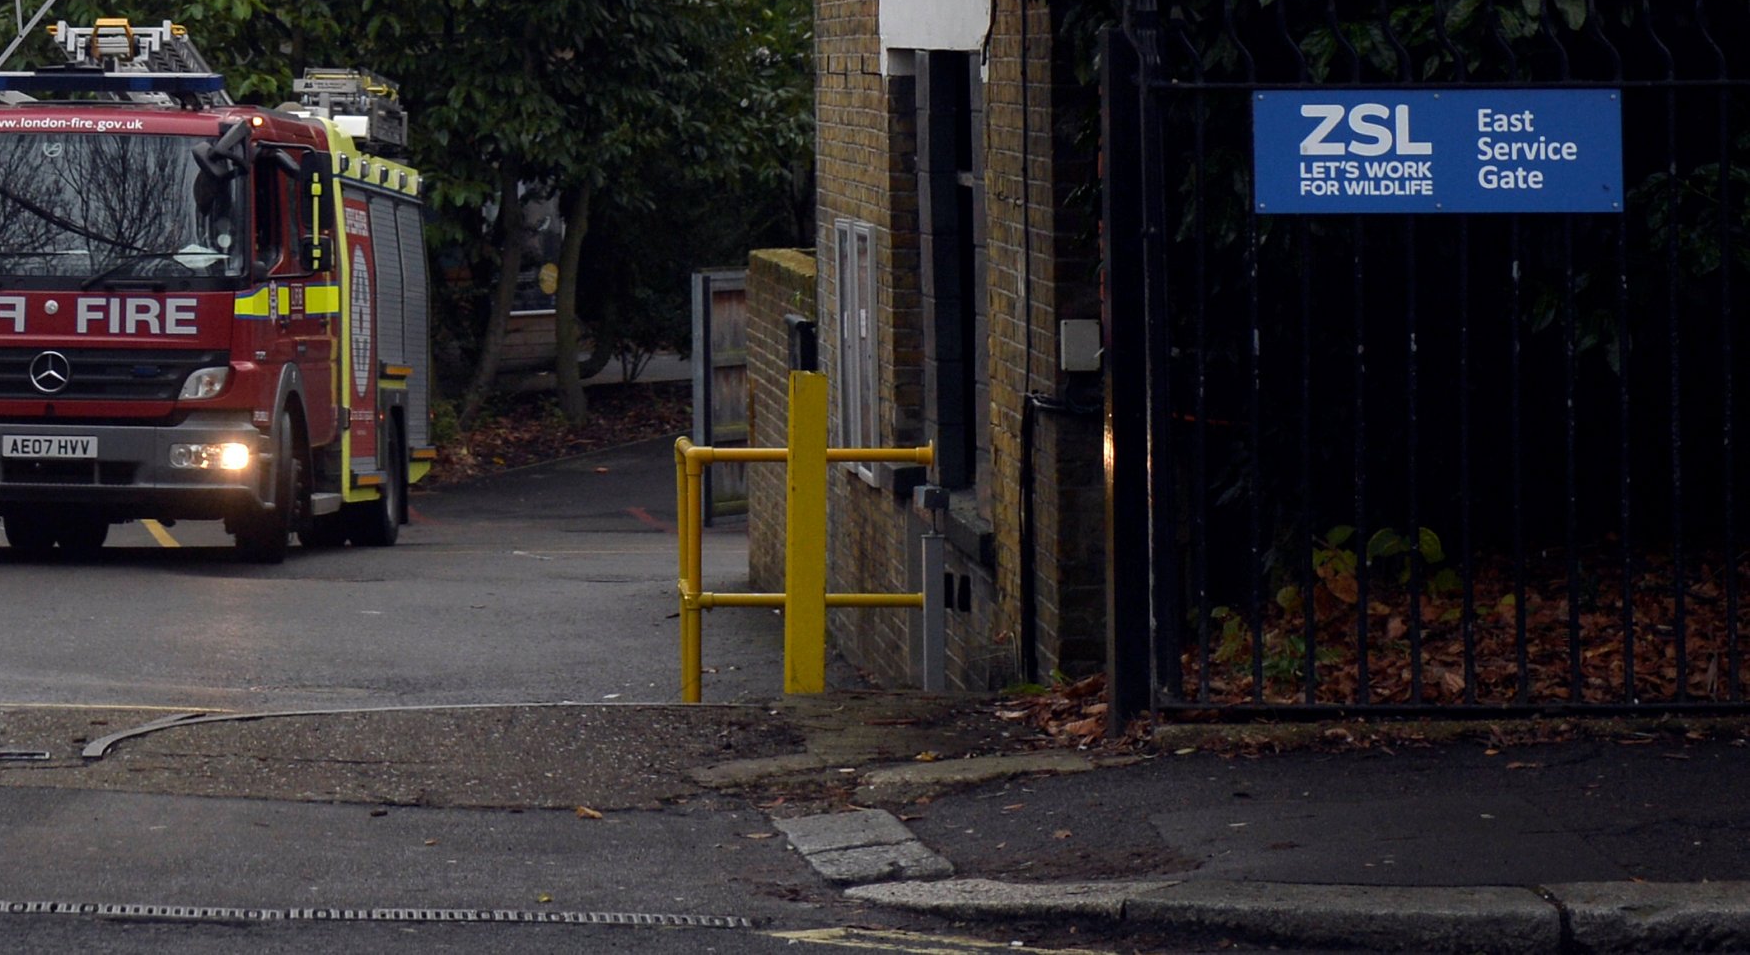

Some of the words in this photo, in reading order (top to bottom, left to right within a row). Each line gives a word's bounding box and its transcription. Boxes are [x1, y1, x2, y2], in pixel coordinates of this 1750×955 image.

[1300, 103, 1432, 156] ZSL
[1477, 108, 1534, 132] East
[1477, 136, 1578, 161] Service
[1300, 161, 1360, 179] LET'S
[1365, 161, 1432, 179] WORK
[1478, 165, 1544, 189] Gate
[1300, 180, 1340, 196] FOR
[1344, 180, 1434, 196] WILDLIFE
[76, 297, 198, 335] FIRE
[10, 439, 53, 455] AE07
[58, 439, 90, 455] HVV
